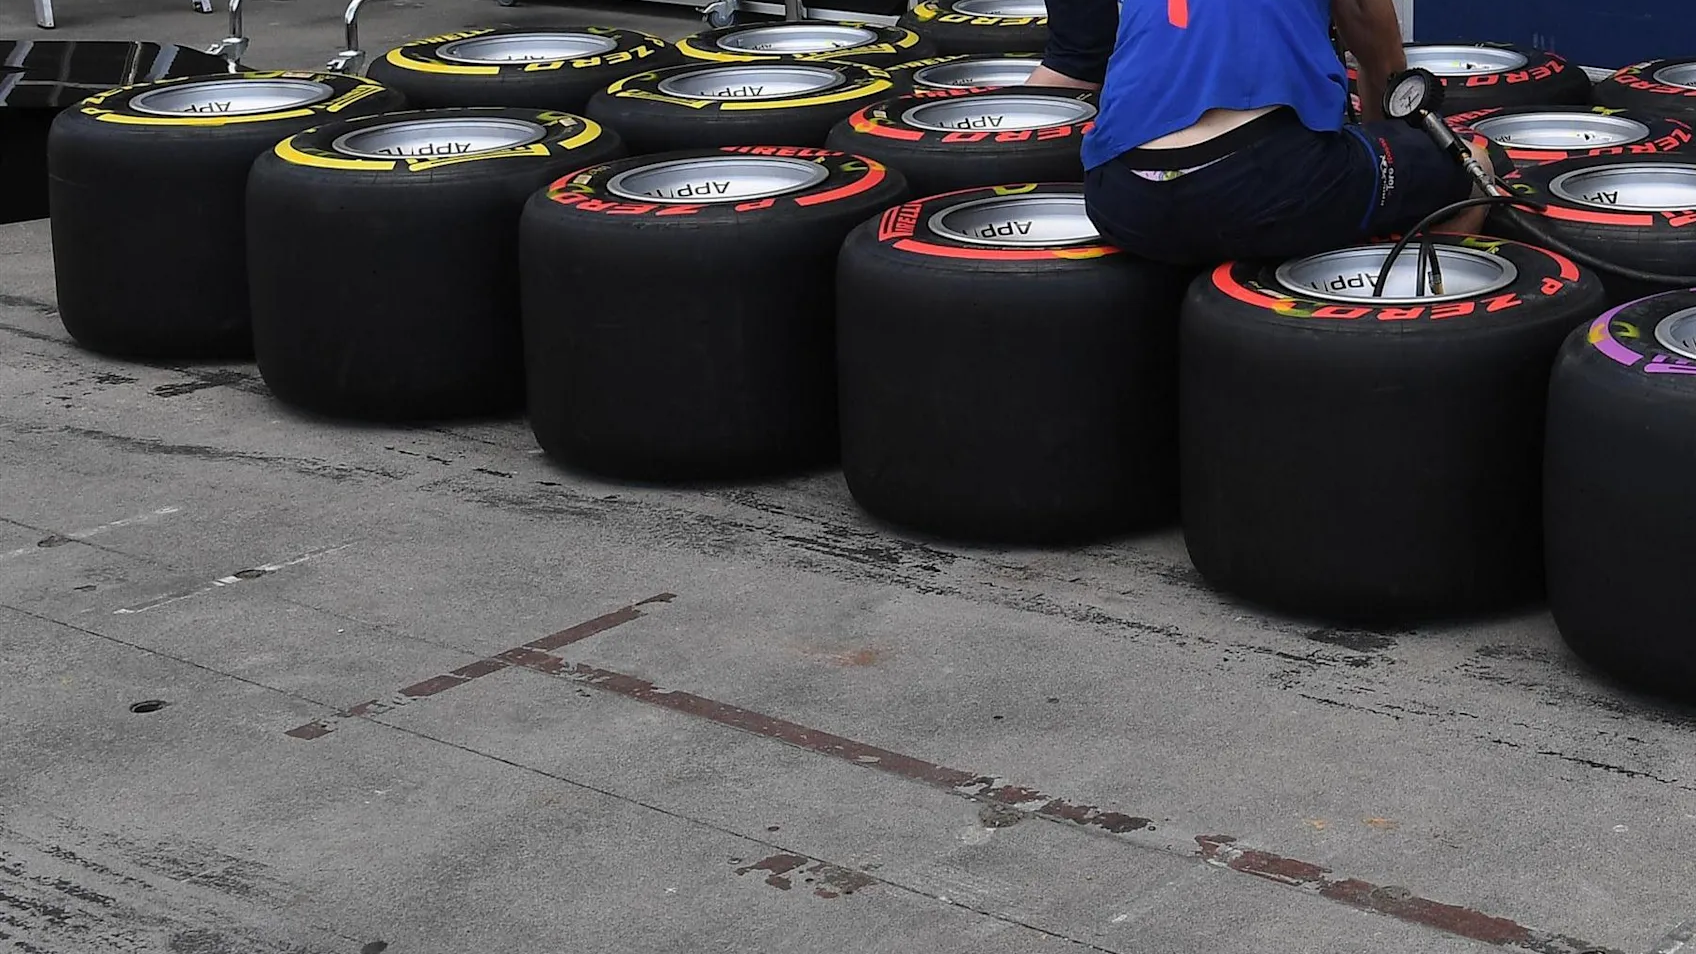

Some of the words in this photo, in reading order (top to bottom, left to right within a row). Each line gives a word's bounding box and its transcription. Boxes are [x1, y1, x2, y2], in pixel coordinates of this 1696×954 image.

[523, 46, 656, 72] ZERO
[1464, 59, 1566, 88] ZERO
[957, 115, 1004, 130] APP
[549, 192, 710, 216] ZERO
[878, 200, 923, 243] PIRELLI
[980, 220, 1033, 239] APP
[1309, 292, 1525, 321] ZERO
